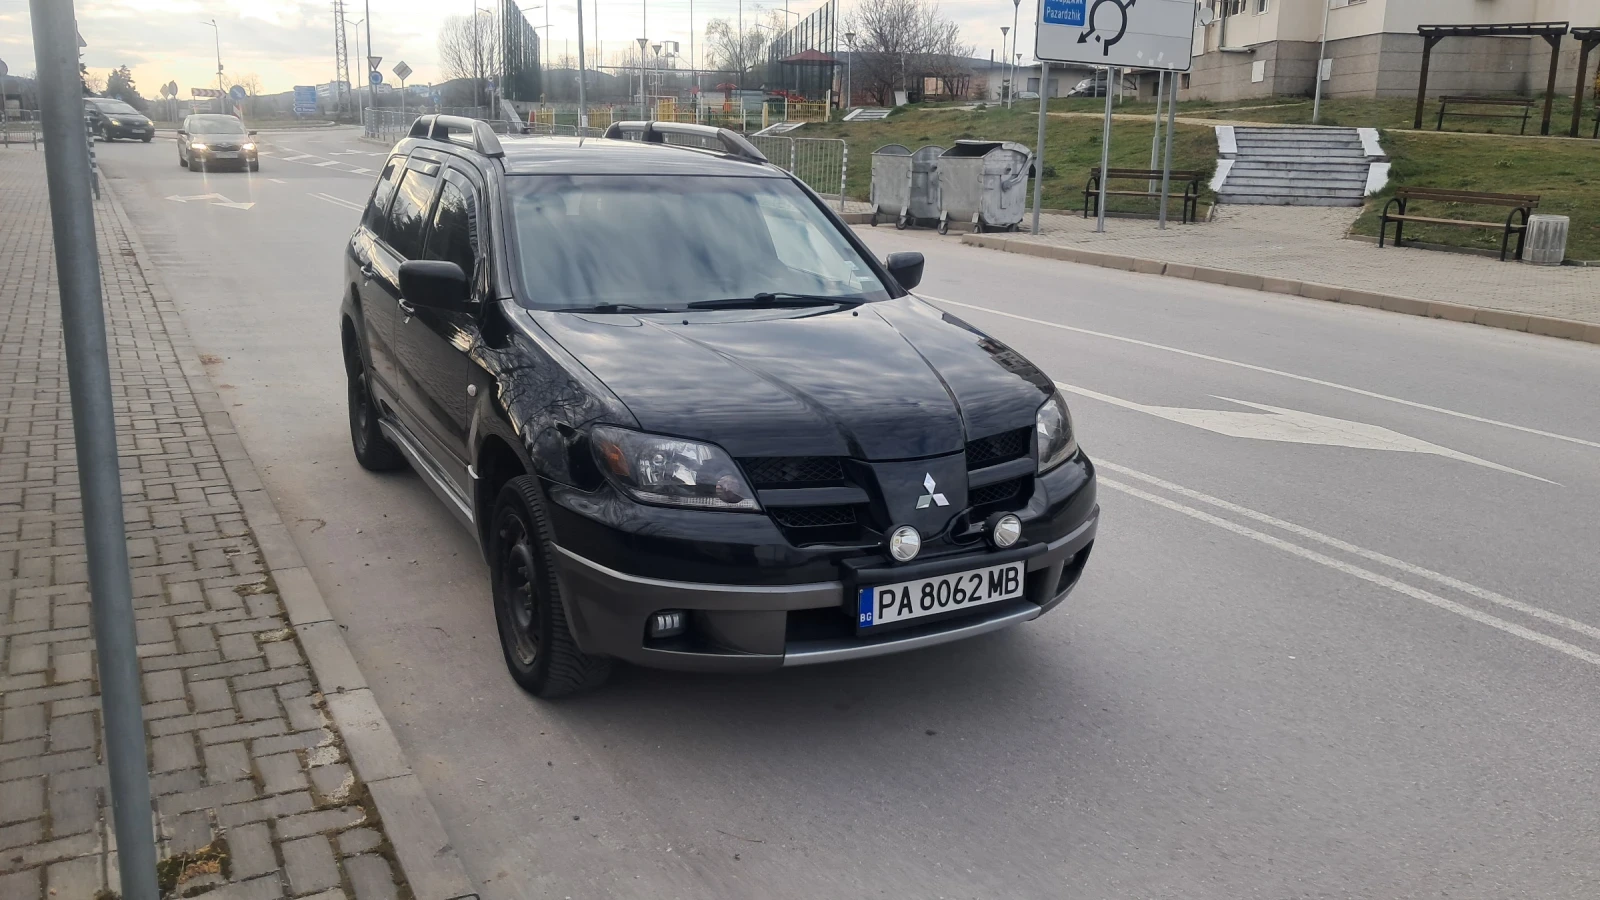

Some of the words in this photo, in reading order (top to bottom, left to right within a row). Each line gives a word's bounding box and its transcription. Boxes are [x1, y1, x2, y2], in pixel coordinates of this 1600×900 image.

[1046, 6, 1081, 20] Pazardzhik
[878, 586, 913, 619] PA
[920, 573, 983, 611] 8062
[988, 566, 1019, 598] MB
[860, 612, 872, 622] BG
